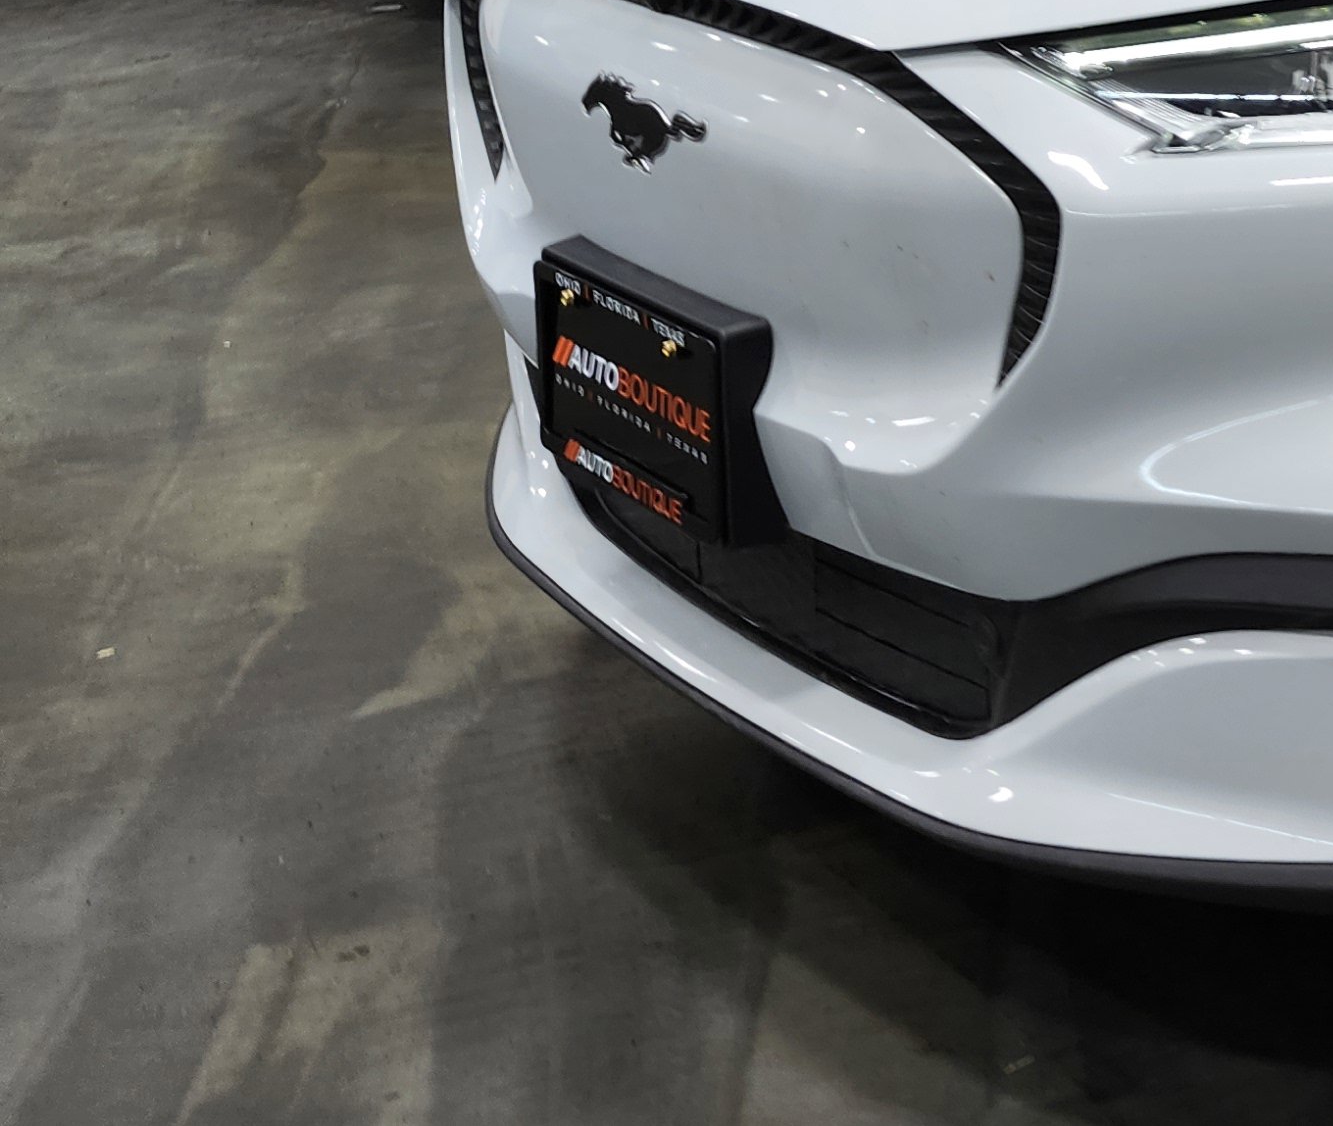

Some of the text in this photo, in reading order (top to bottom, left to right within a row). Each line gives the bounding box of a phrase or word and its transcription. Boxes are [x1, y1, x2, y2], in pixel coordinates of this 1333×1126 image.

[592, 289, 641, 326] FLORIDA
[567, 344, 711, 443] AUTOBOUTIQUE
[574, 441, 684, 525] AUTOBOUTIQUE
